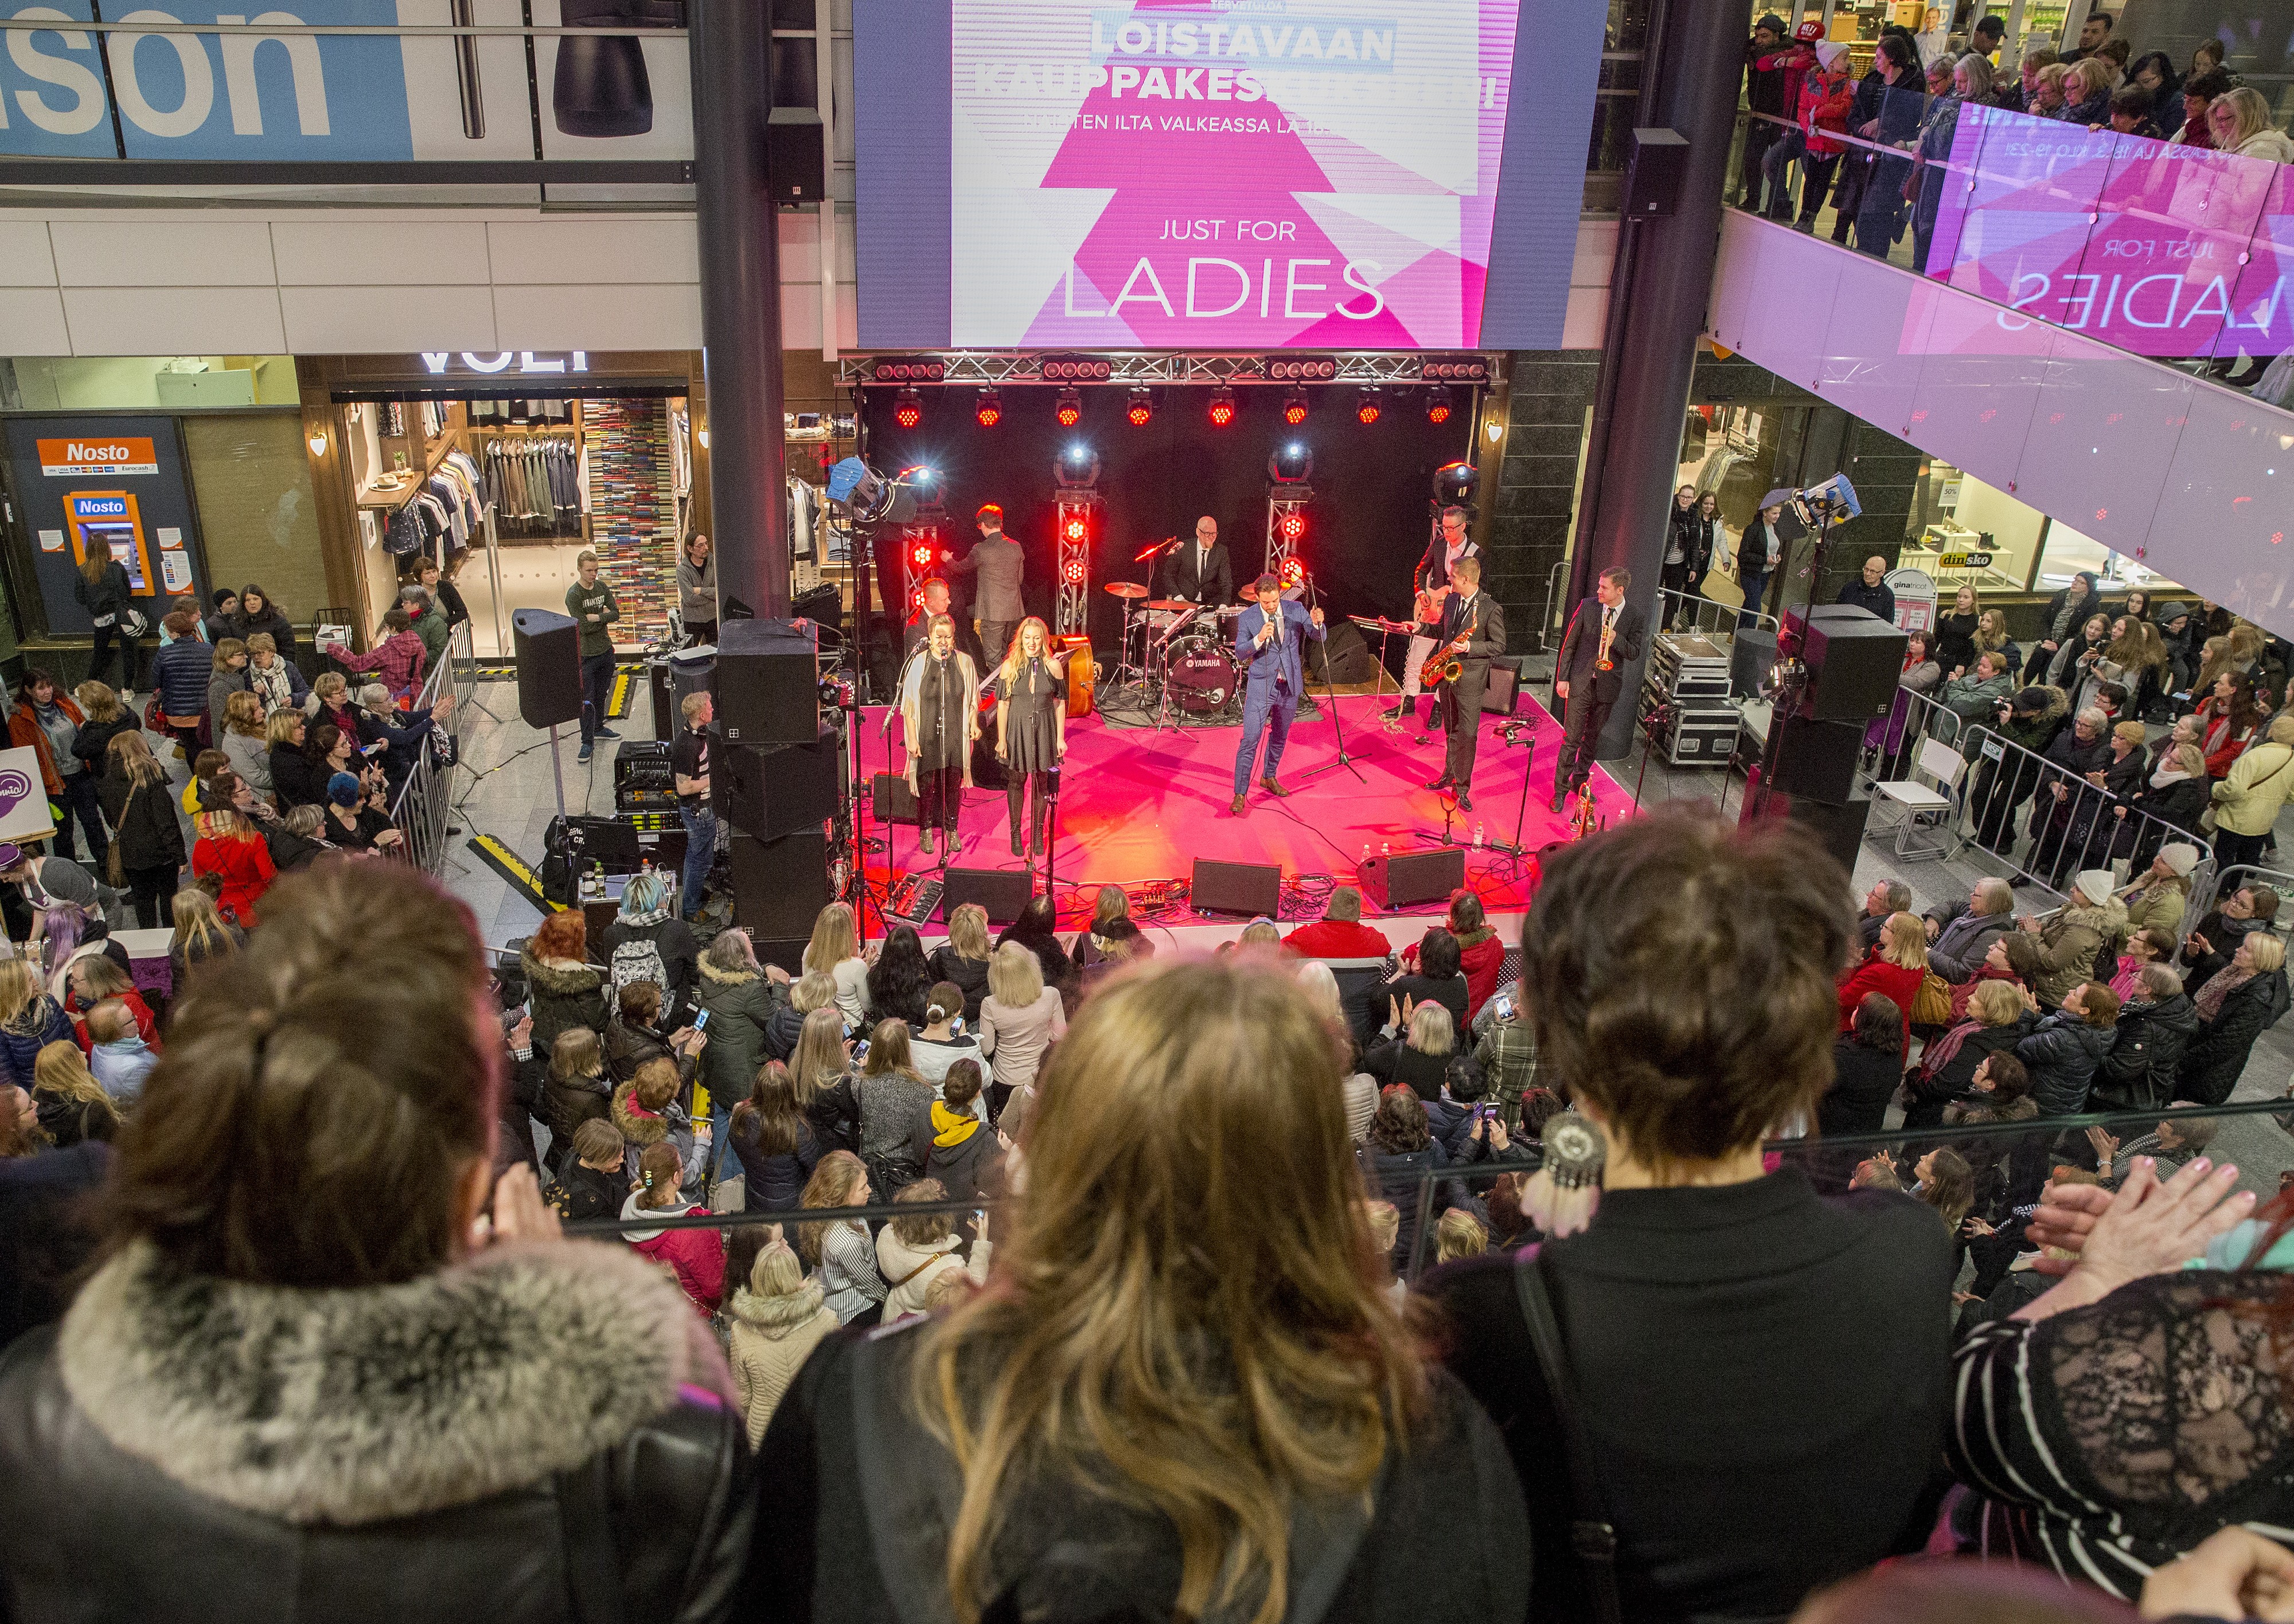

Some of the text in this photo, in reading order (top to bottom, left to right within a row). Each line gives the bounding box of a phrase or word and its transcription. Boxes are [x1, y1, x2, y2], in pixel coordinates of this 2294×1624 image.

[1093, 19, 1392, 61] LOISTAVAAN
[0, 7, 330, 138] son
[1115, 114, 1153, 130] ILTA
[1160, 116, 1271, 133] VALKEASSA
[1160, 219, 1296, 241] JUST FOR
[1064, 256, 1384, 319] LADIES
[67, 443, 129, 461] Nosto
[80, 501, 123, 513] Nosto
[1195, 659, 1220, 667] YAMAHA
[1985, 741, 2000, 756] MSP
